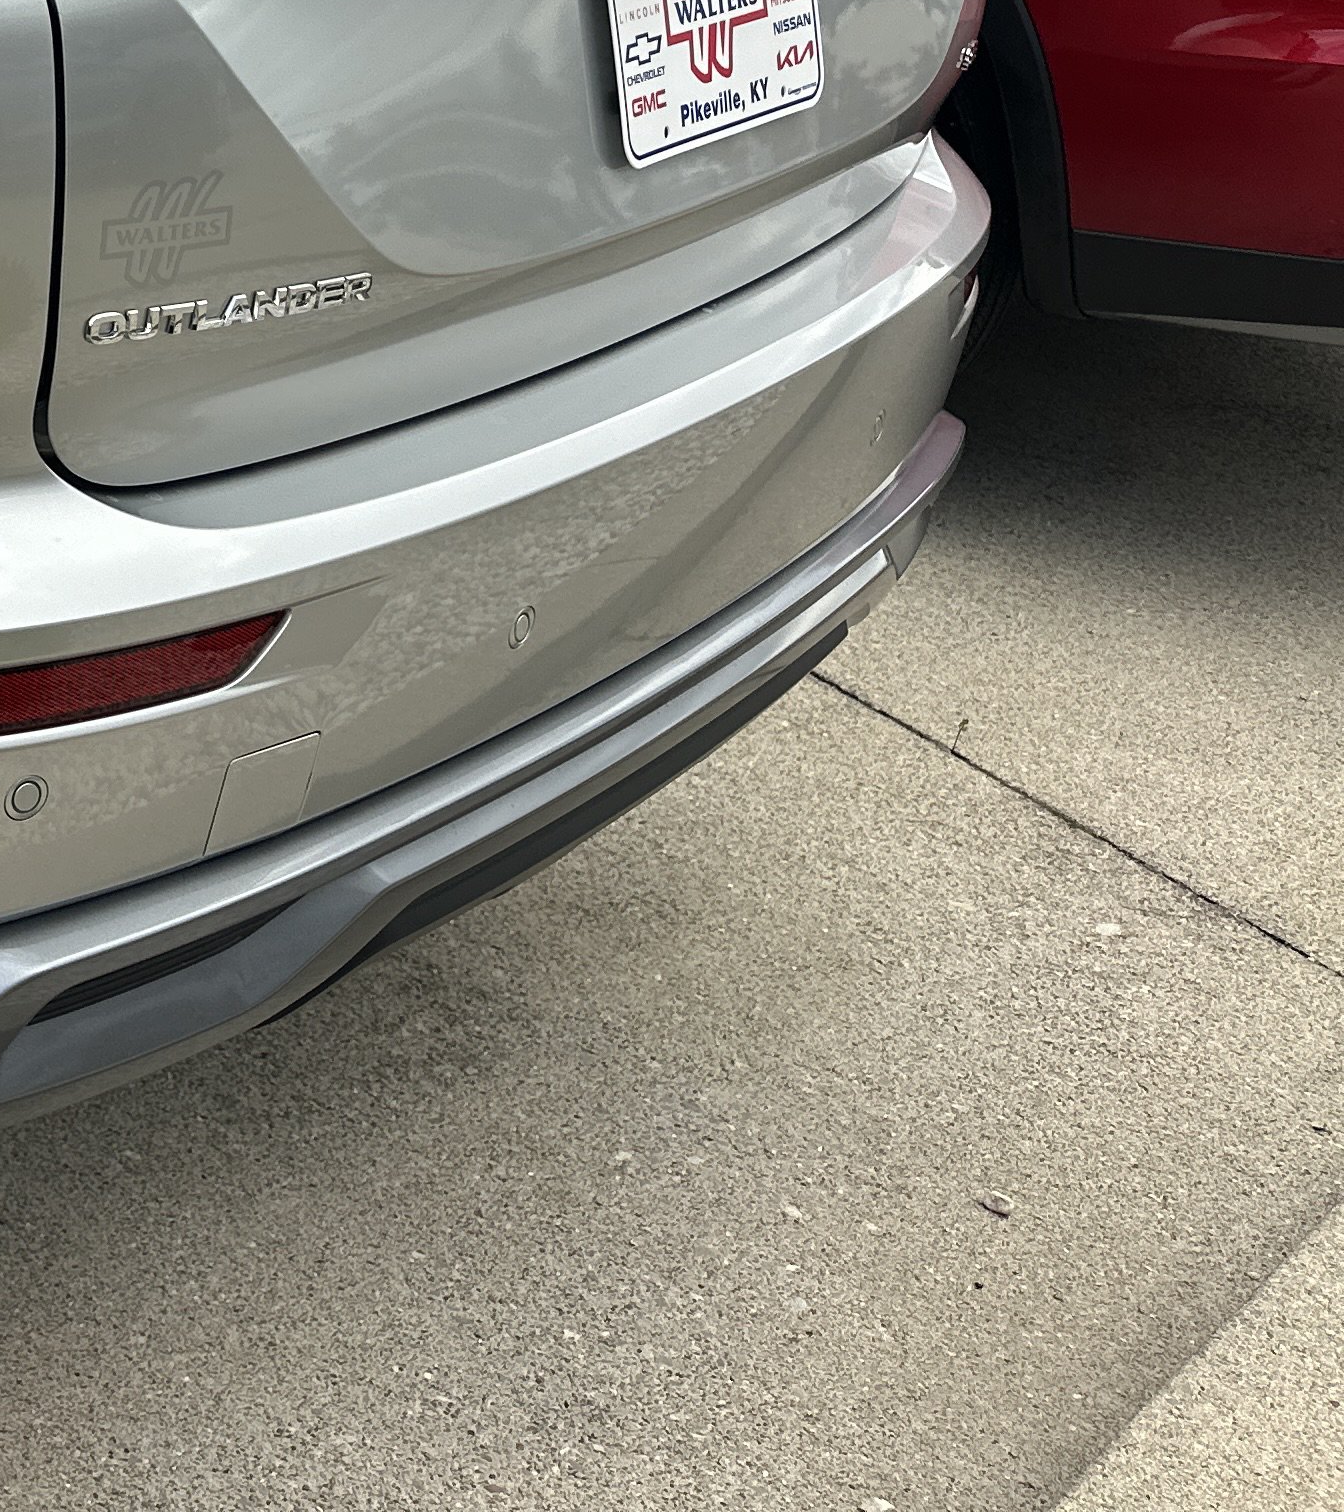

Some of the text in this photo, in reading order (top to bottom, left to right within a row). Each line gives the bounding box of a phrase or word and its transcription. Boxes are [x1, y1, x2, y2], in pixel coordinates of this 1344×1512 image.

[618, 3, 661, 25] LINCOLN
[773, 13, 811, 35] NISSAN
[626, 66, 666, 87] CHEVROLET
[631, 89, 668, 118] GMC
[680, 89, 746, 128] Pikeville,
[749, 77, 769, 103] KY
[115, 219, 222, 247] WALTERS
[83, 271, 374, 346] OUTLANDER
